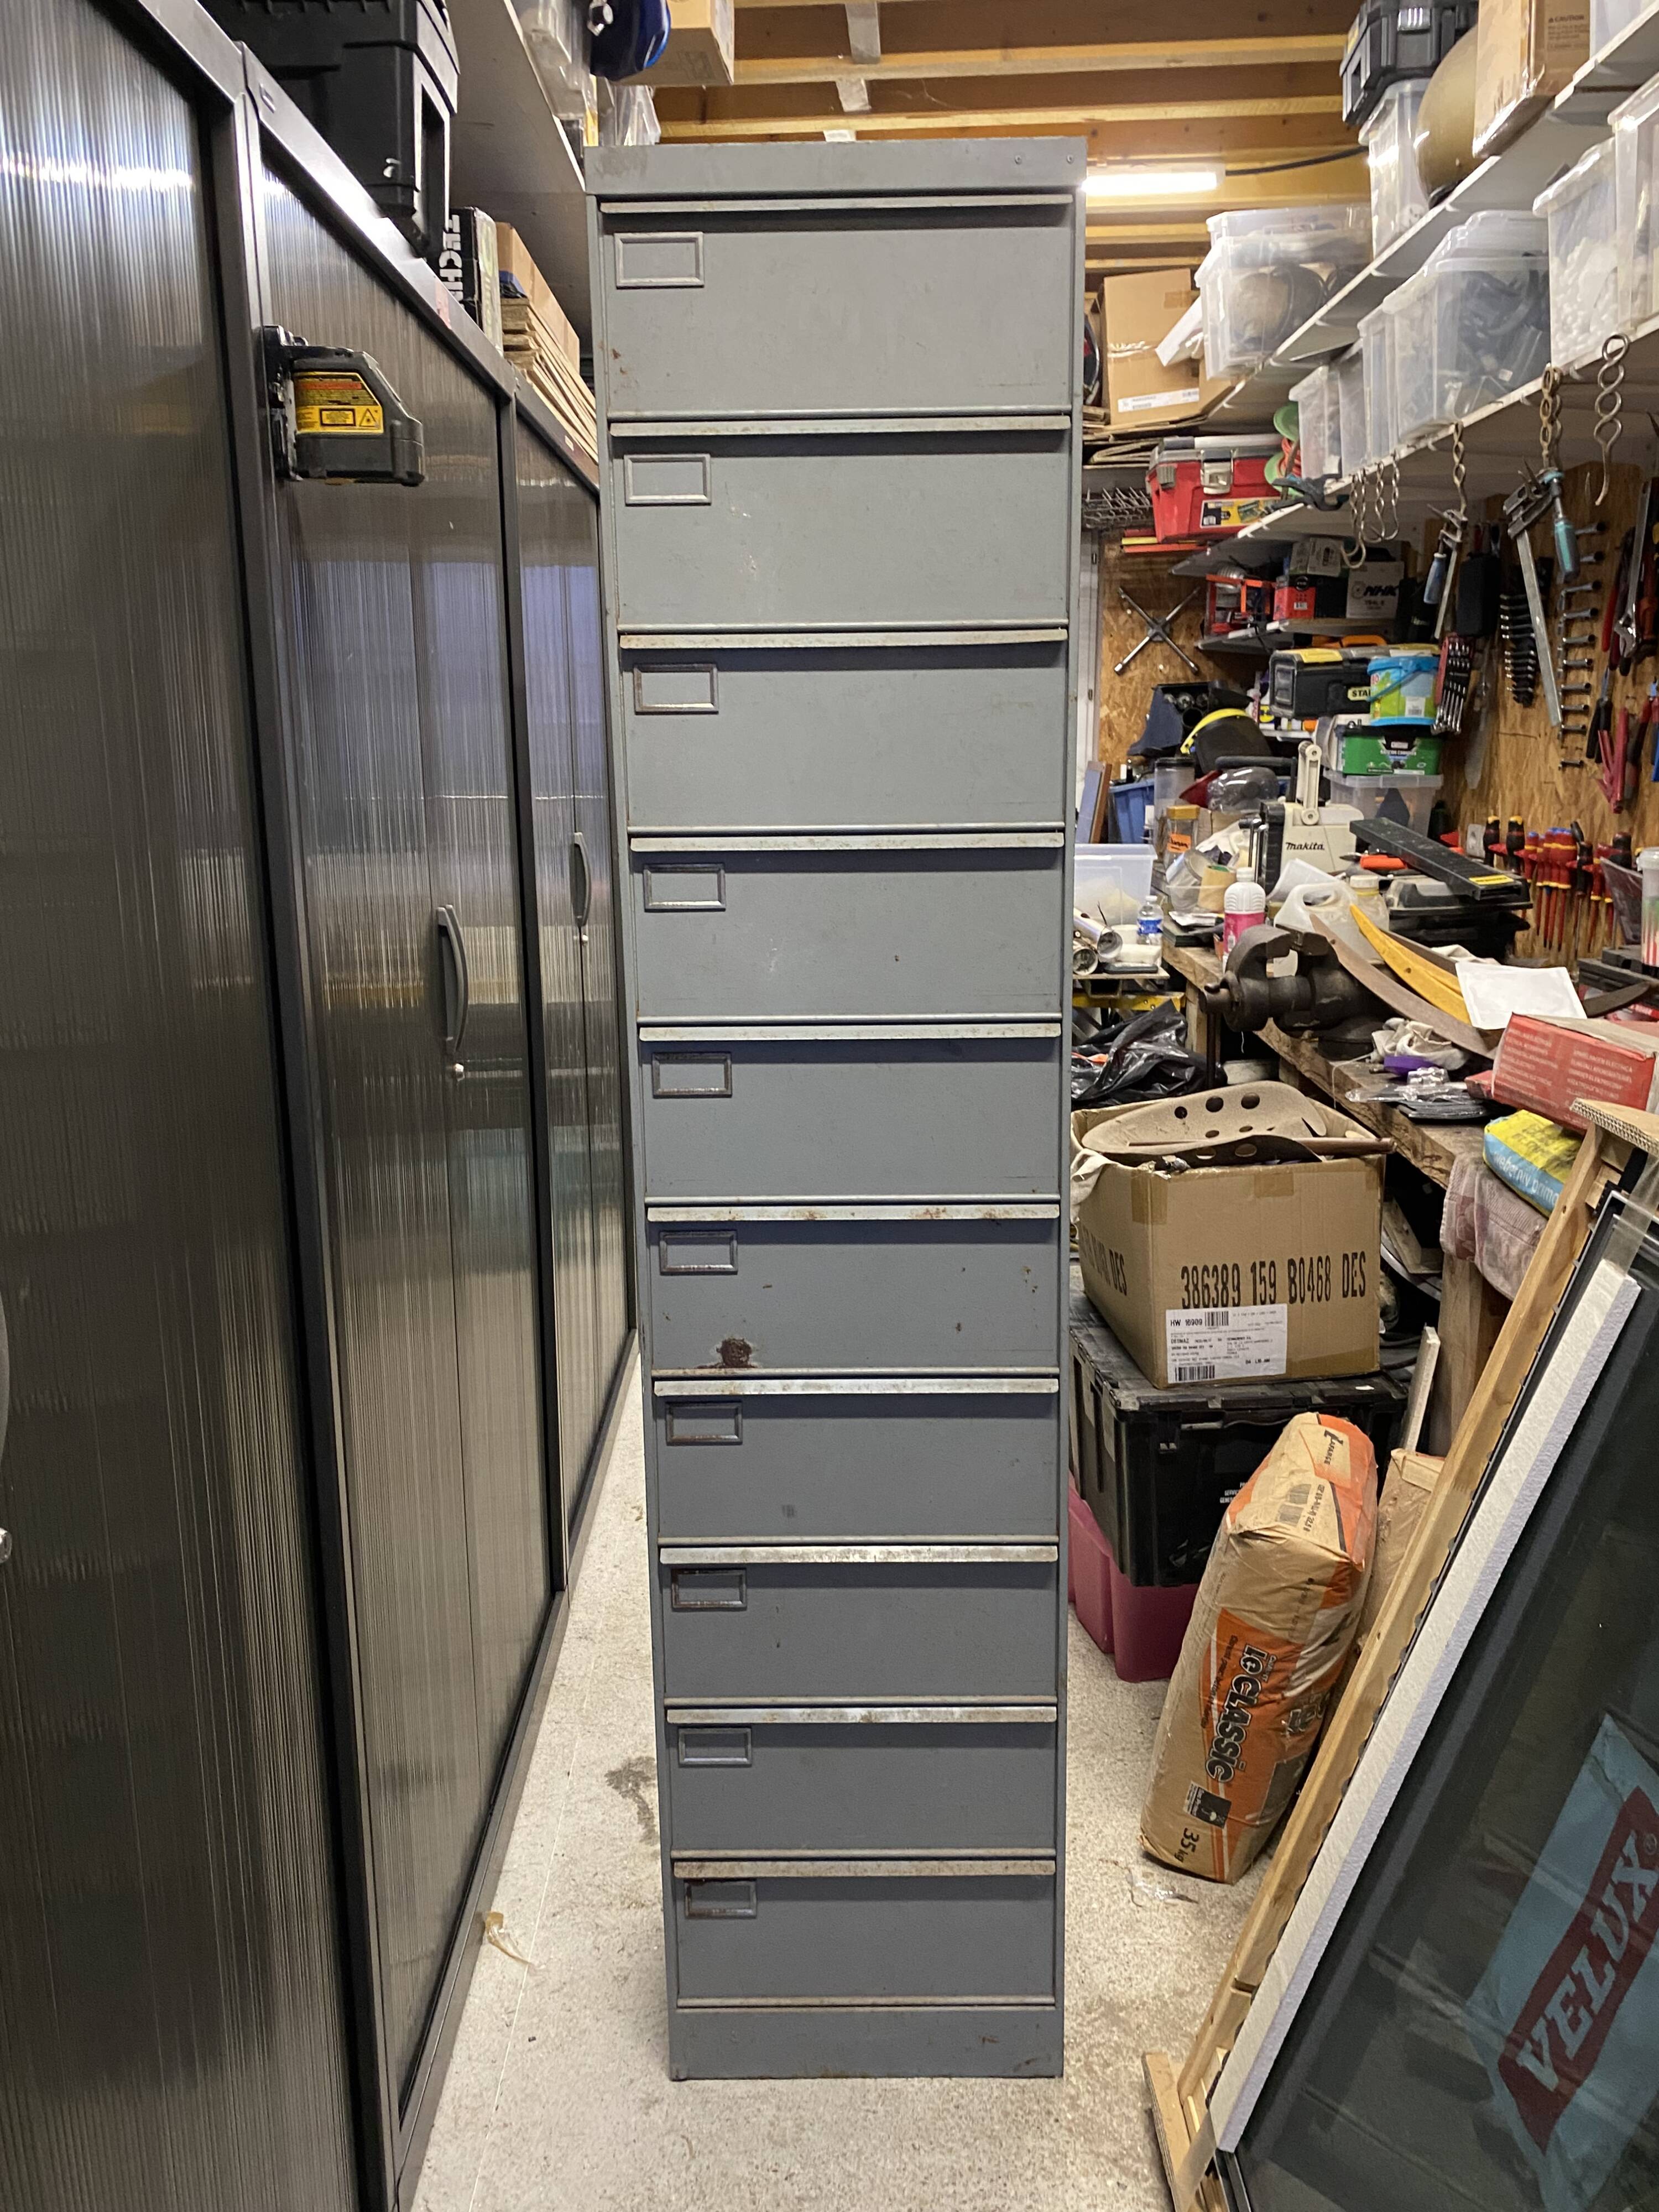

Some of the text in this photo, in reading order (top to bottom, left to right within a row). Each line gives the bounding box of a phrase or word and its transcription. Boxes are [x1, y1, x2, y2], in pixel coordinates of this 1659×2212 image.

[1286, 842, 1325, 851] makita
[1109, 1248, 1127, 1296] DES
[1181, 1251, 1366, 1310] 386389 159 B0468 DES
[1324, 1430, 1344, 1465] LAFARGE
[1173, 1848, 1188, 1863] kg
[1181, 1827, 1199, 1853] 35
[1516, 1829, 1659, 2093] VELUX
